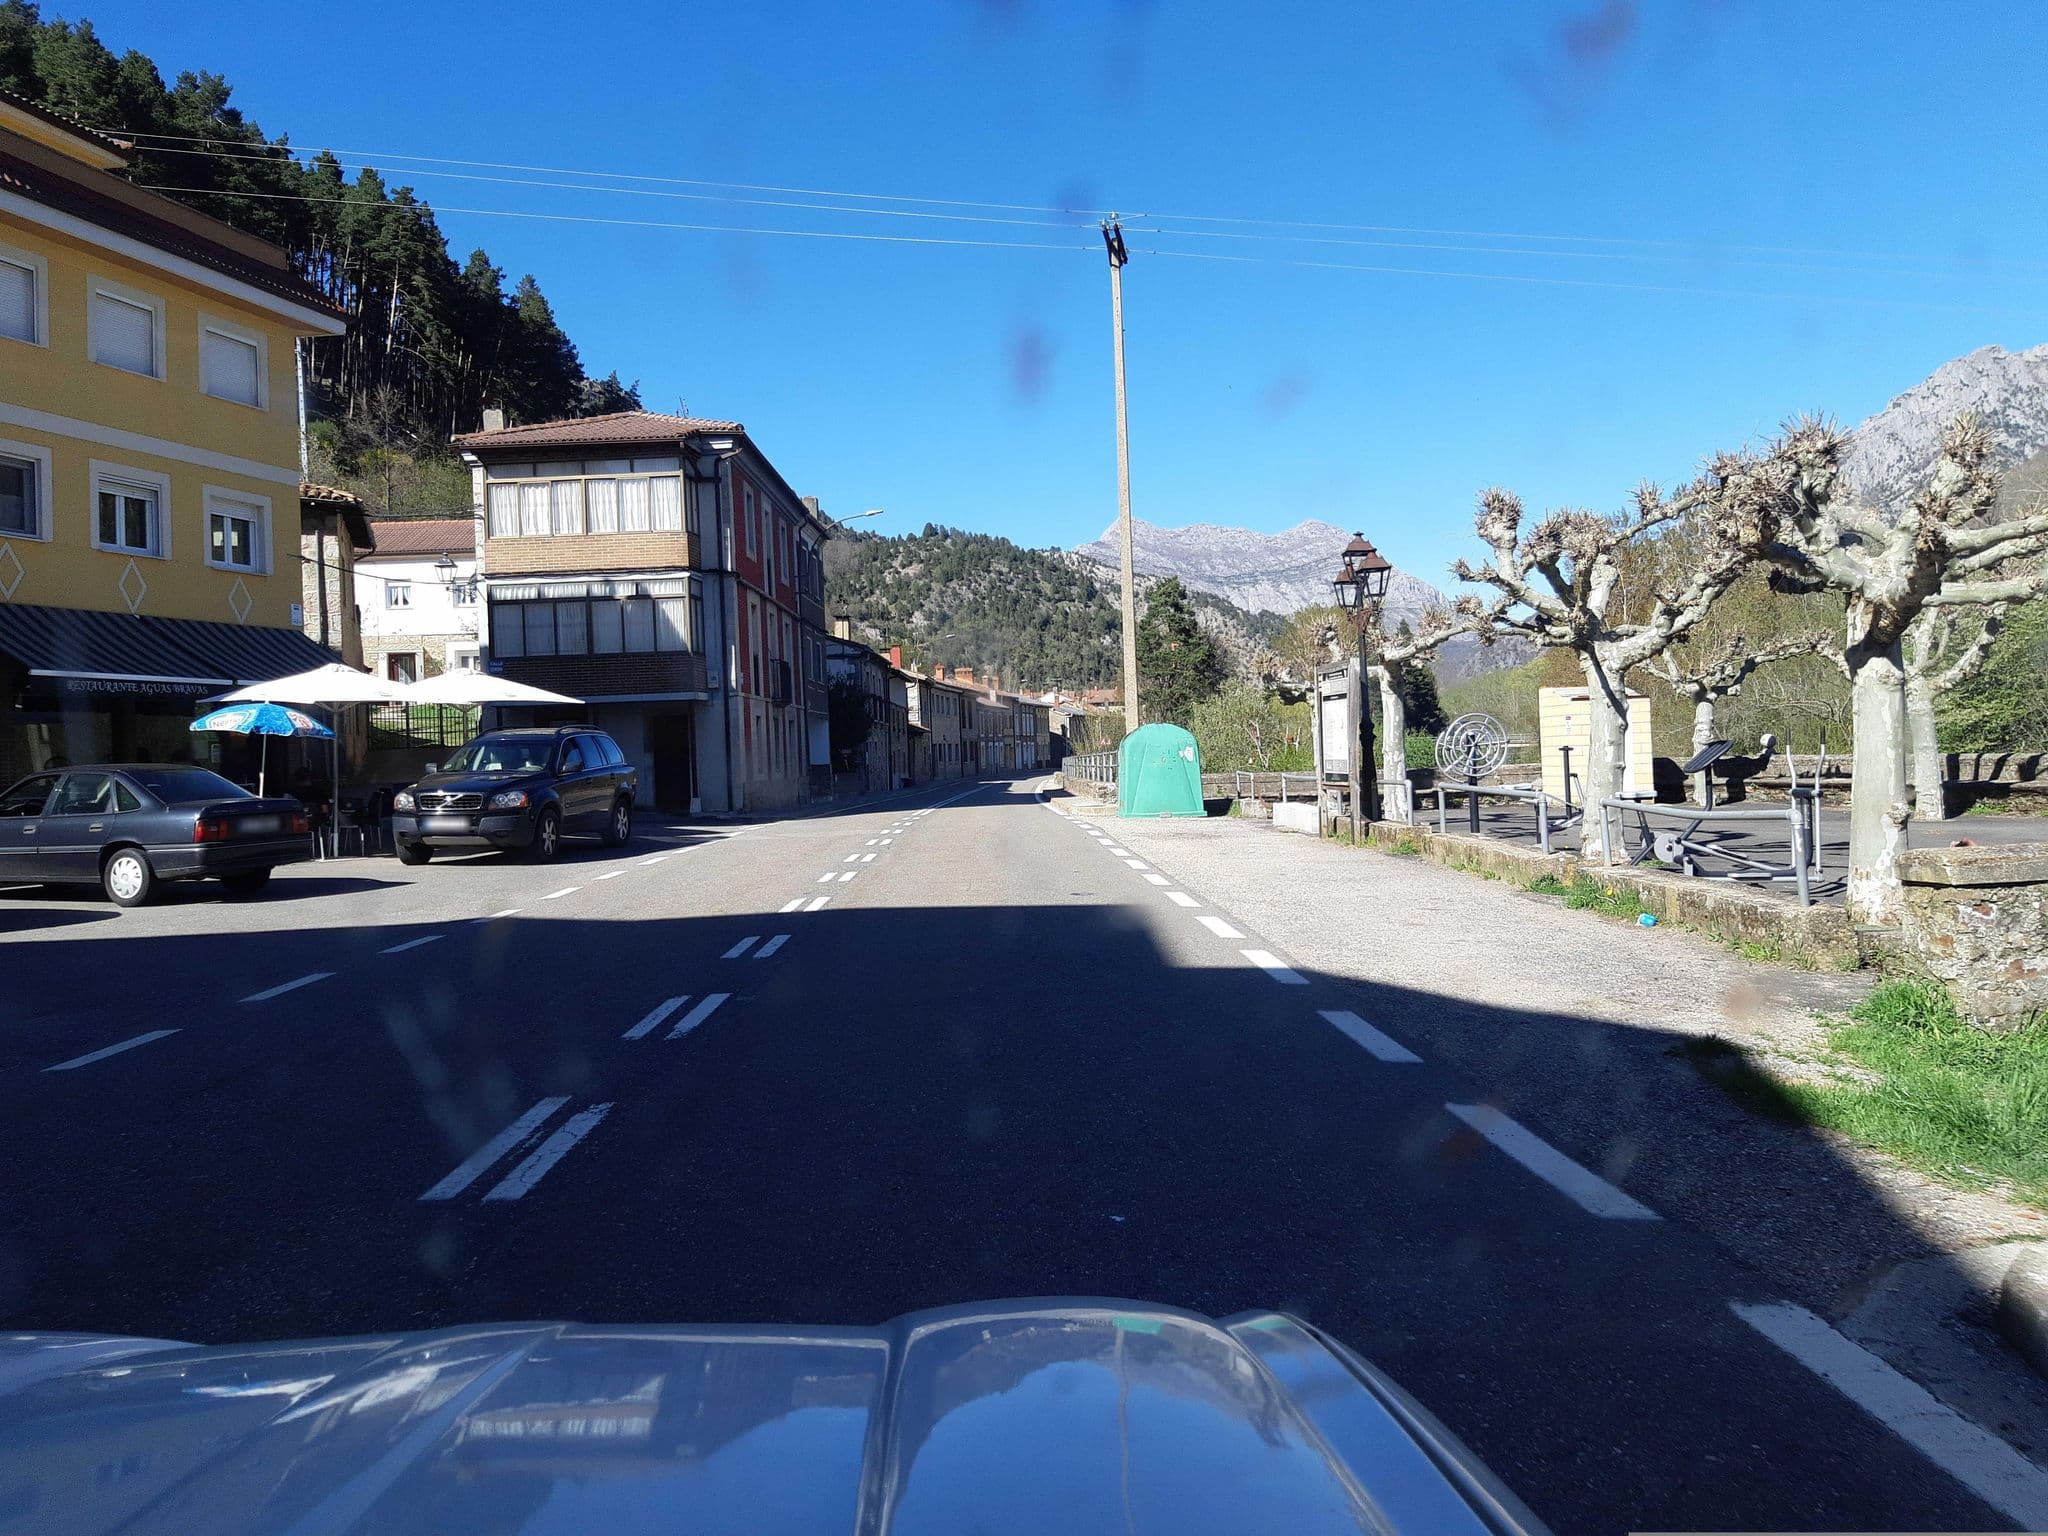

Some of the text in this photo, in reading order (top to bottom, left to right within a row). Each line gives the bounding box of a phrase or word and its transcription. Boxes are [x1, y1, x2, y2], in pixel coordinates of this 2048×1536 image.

[66, 680, 208, 695] RESTAURANTE AGUAS BRAVAS
